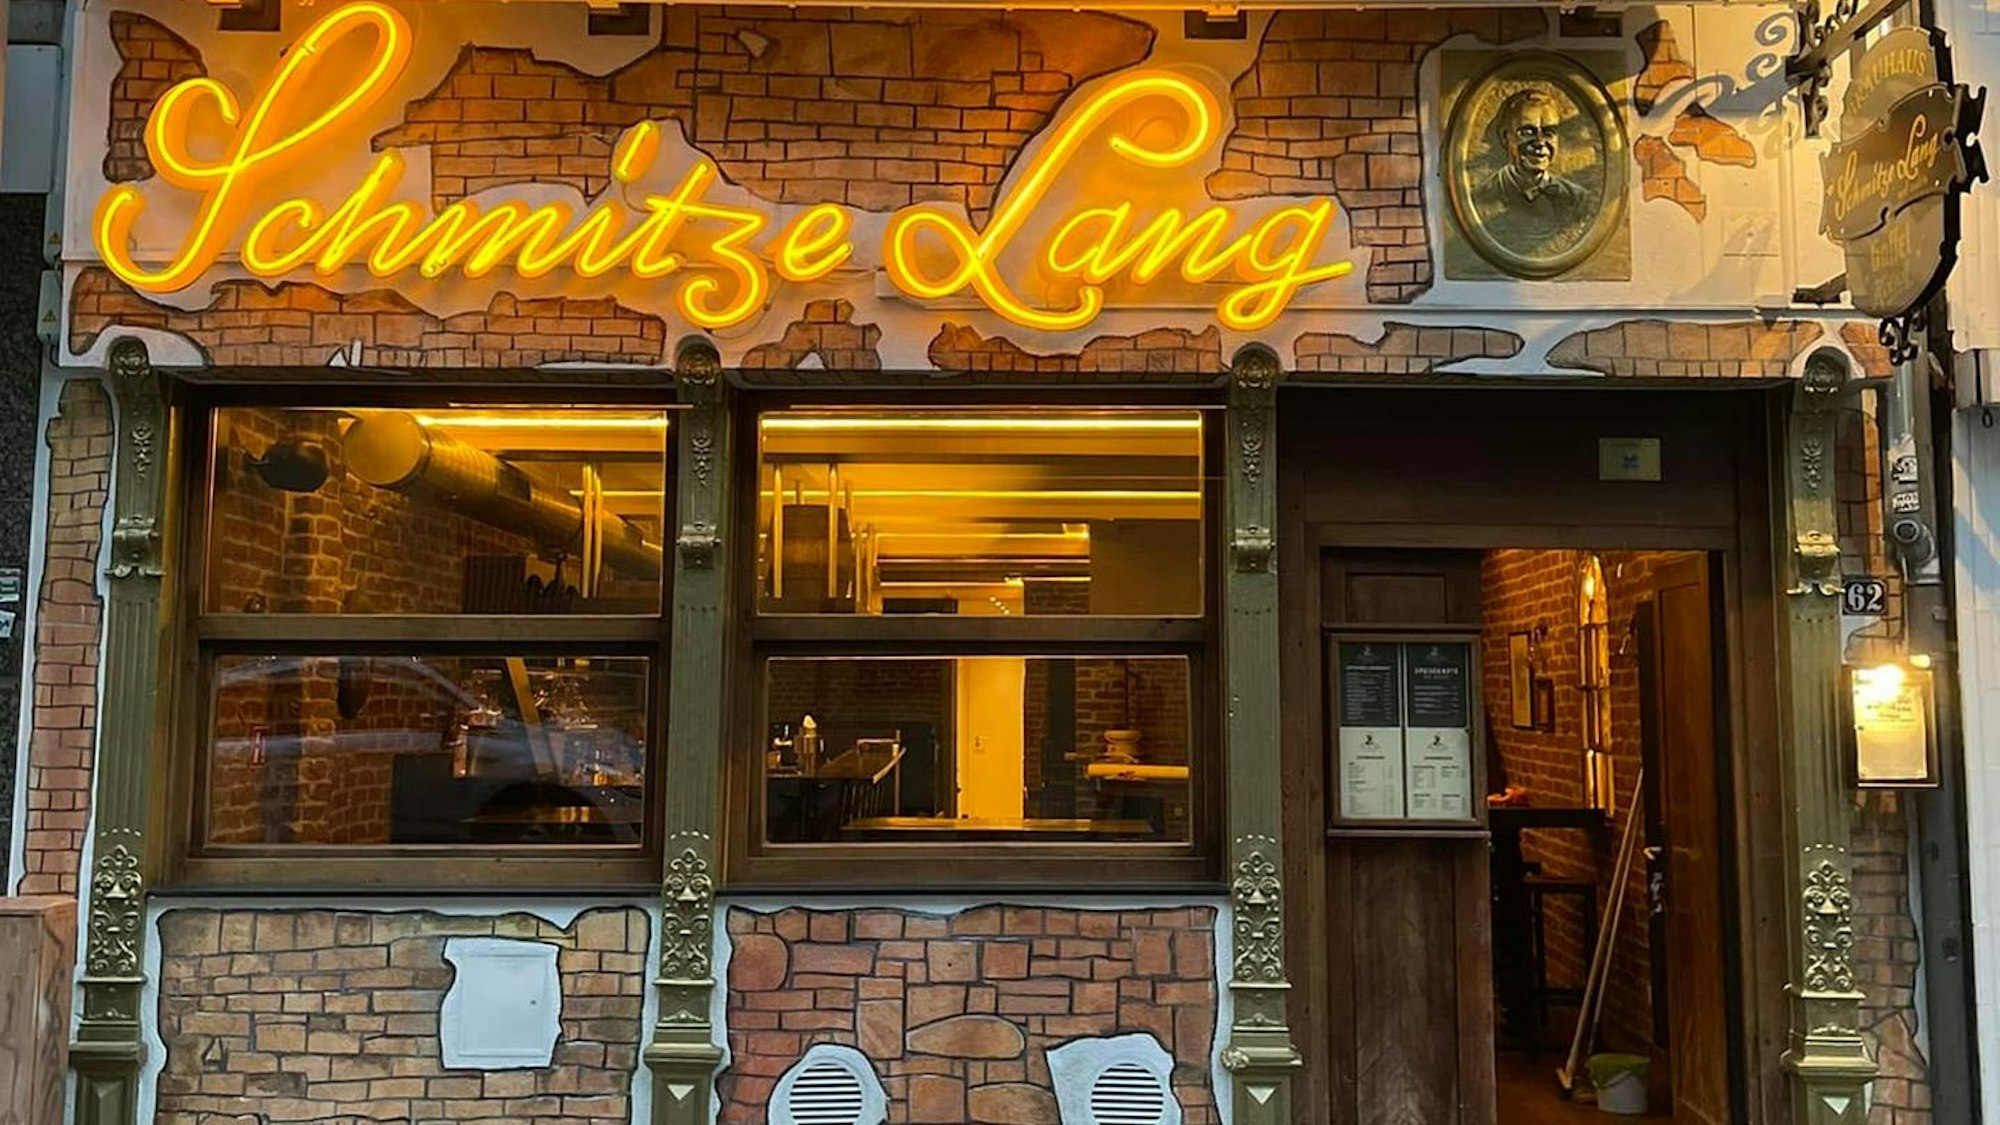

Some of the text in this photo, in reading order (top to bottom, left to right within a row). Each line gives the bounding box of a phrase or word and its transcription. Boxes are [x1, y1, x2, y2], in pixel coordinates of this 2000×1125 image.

[98, 1, 1353, 331] Schmitze Lang
[1836, 113, 1940, 220] Schmitze Lang
[1847, 582, 1883, 612] 62
